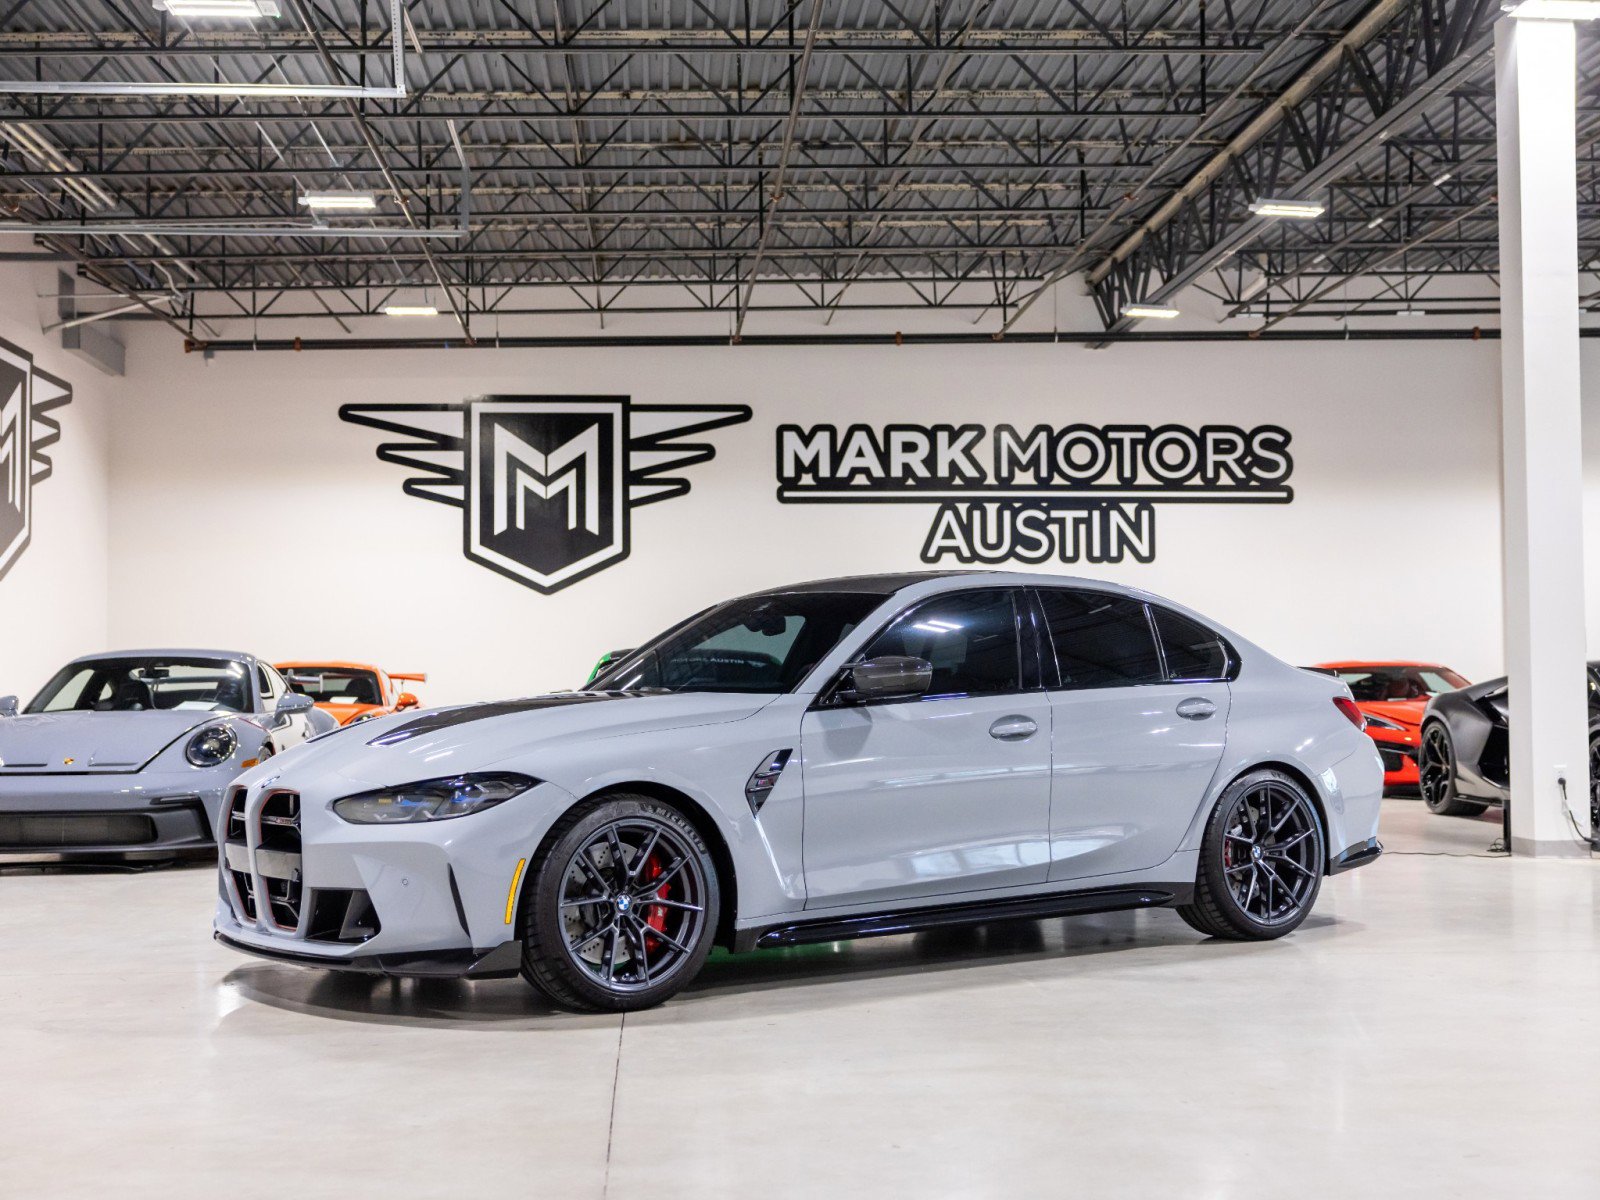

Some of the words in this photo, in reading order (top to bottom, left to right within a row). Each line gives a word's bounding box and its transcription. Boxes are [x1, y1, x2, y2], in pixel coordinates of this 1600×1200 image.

[780, 428, 982, 480] MARK
[998, 428, 1288, 481] MOTORS
[924, 507, 1153, 560] AUSTIN
[710, 657, 745, 665] AUSTIN
[655, 806, 706, 852] MICHELIN
